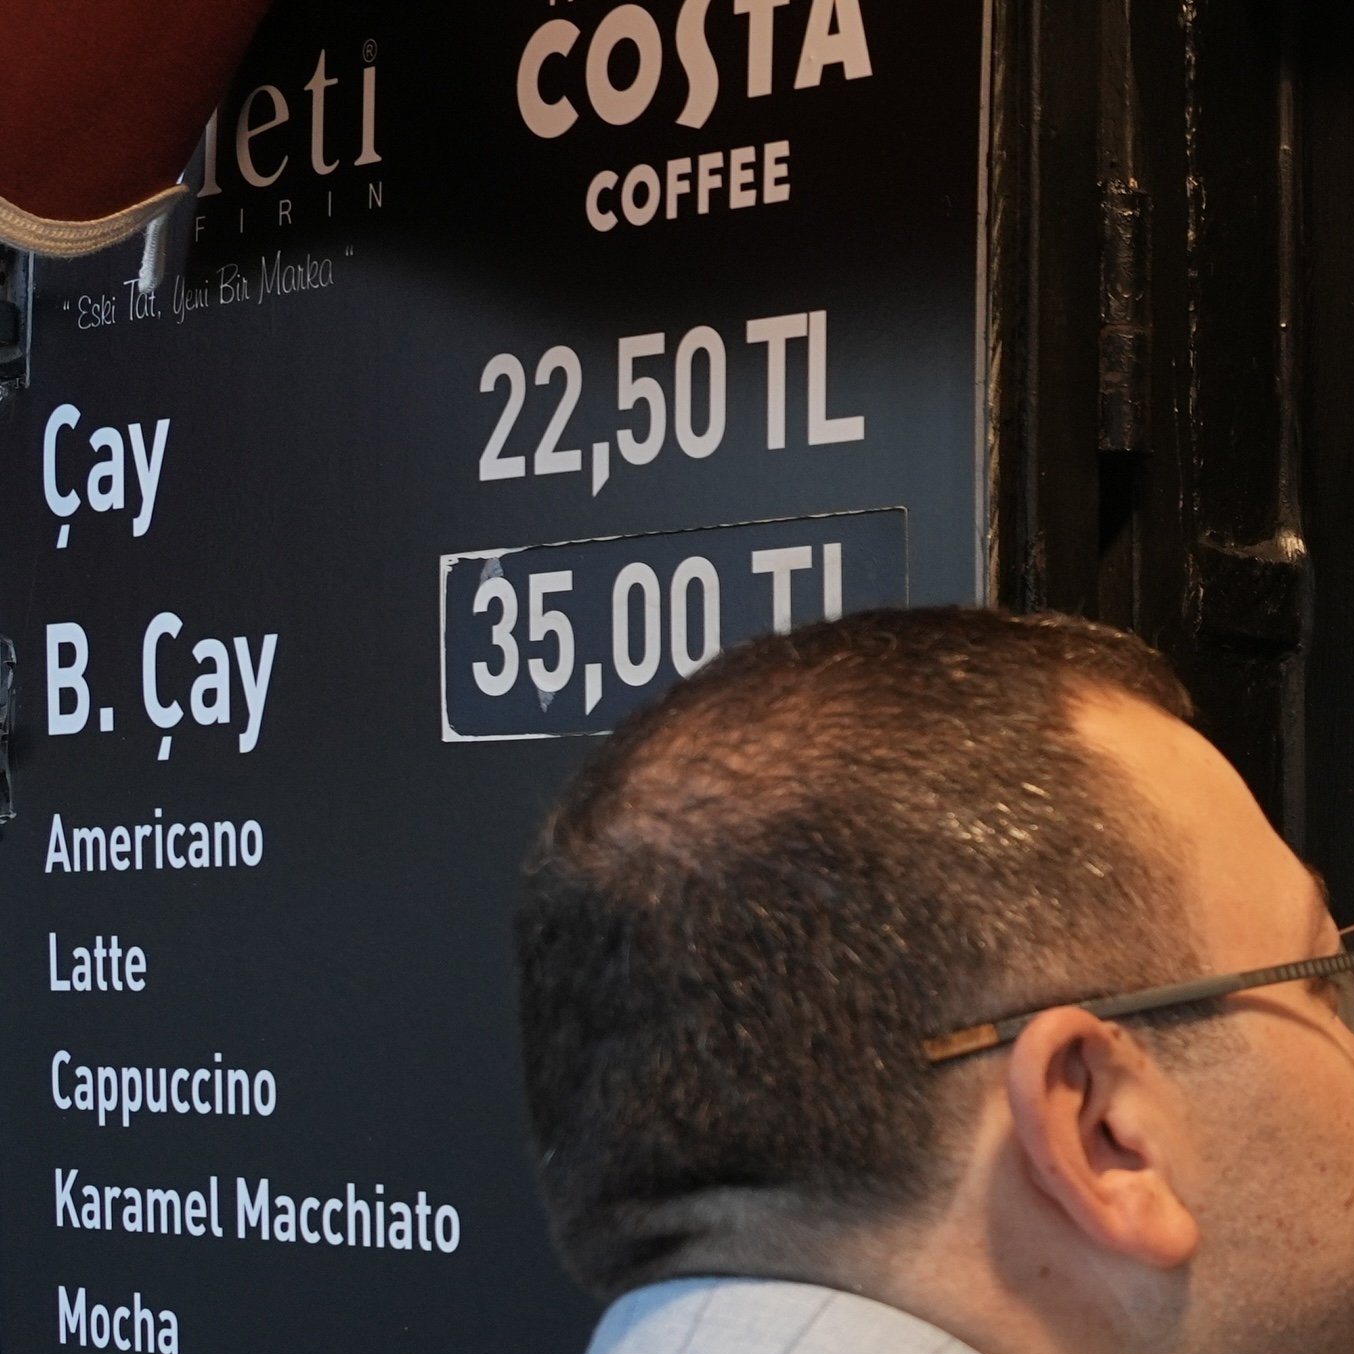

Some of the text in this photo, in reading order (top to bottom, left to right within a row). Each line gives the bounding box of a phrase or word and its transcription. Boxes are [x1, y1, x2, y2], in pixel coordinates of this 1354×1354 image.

[516, 0, 873, 138] COSTA
[196, 48, 382, 198] leti
[195, 181, 382, 242] FIRIN
[586, 140, 790, 232] COFFEE
[78, 295, 116, 329] Eski
[173, 275, 209, 325] Yeni
[217, 263, 250, 305] Bir
[258, 250, 334, 305] Marka
[478, 310, 865, 496] 22,50 TL
[43, 403, 170, 549] Çay
[472, 555, 721, 715] 35,00
[46, 611, 278, 761] B. Çay
[45, 808, 263, 874] Americano
[49, 932, 147, 992] Latte
[51, 1049, 277, 1128] Cappuccino
[55, 1168, 461, 1254] Karamel Macchiato
